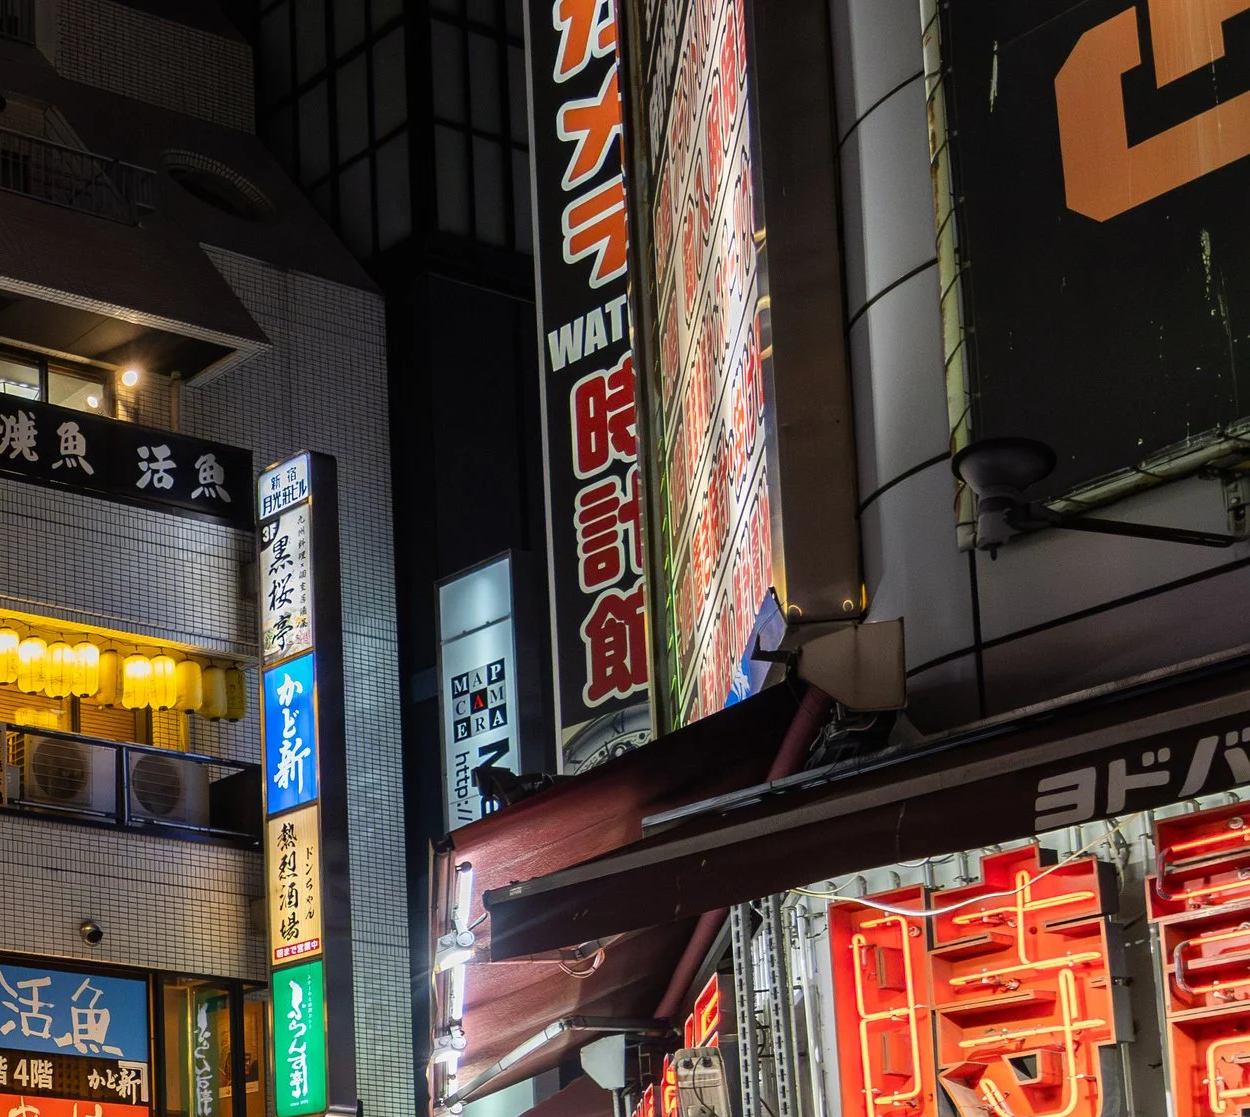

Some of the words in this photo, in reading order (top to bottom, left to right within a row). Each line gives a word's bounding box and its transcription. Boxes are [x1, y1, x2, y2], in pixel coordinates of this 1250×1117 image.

[136, 444, 232, 503] 活魚
[270, 466, 297, 491] 新宿
[262, 481, 308, 517] 月光荘ビル
[261, 522, 278, 544] 3F
[268, 535, 295, 652] 黒桜亭
[454, 663, 502, 695] MAP
[455, 687, 504, 716] CAM
[273, 673, 311, 796] かど新
[456, 710, 504, 739] ERA
[276, 821, 300, 941] 熱烈酒場
[304, 846, 315, 920] ドンちゃん
[13, 1057, 53, 1091] 4階
[87, 1065, 141, 1106] かど新
